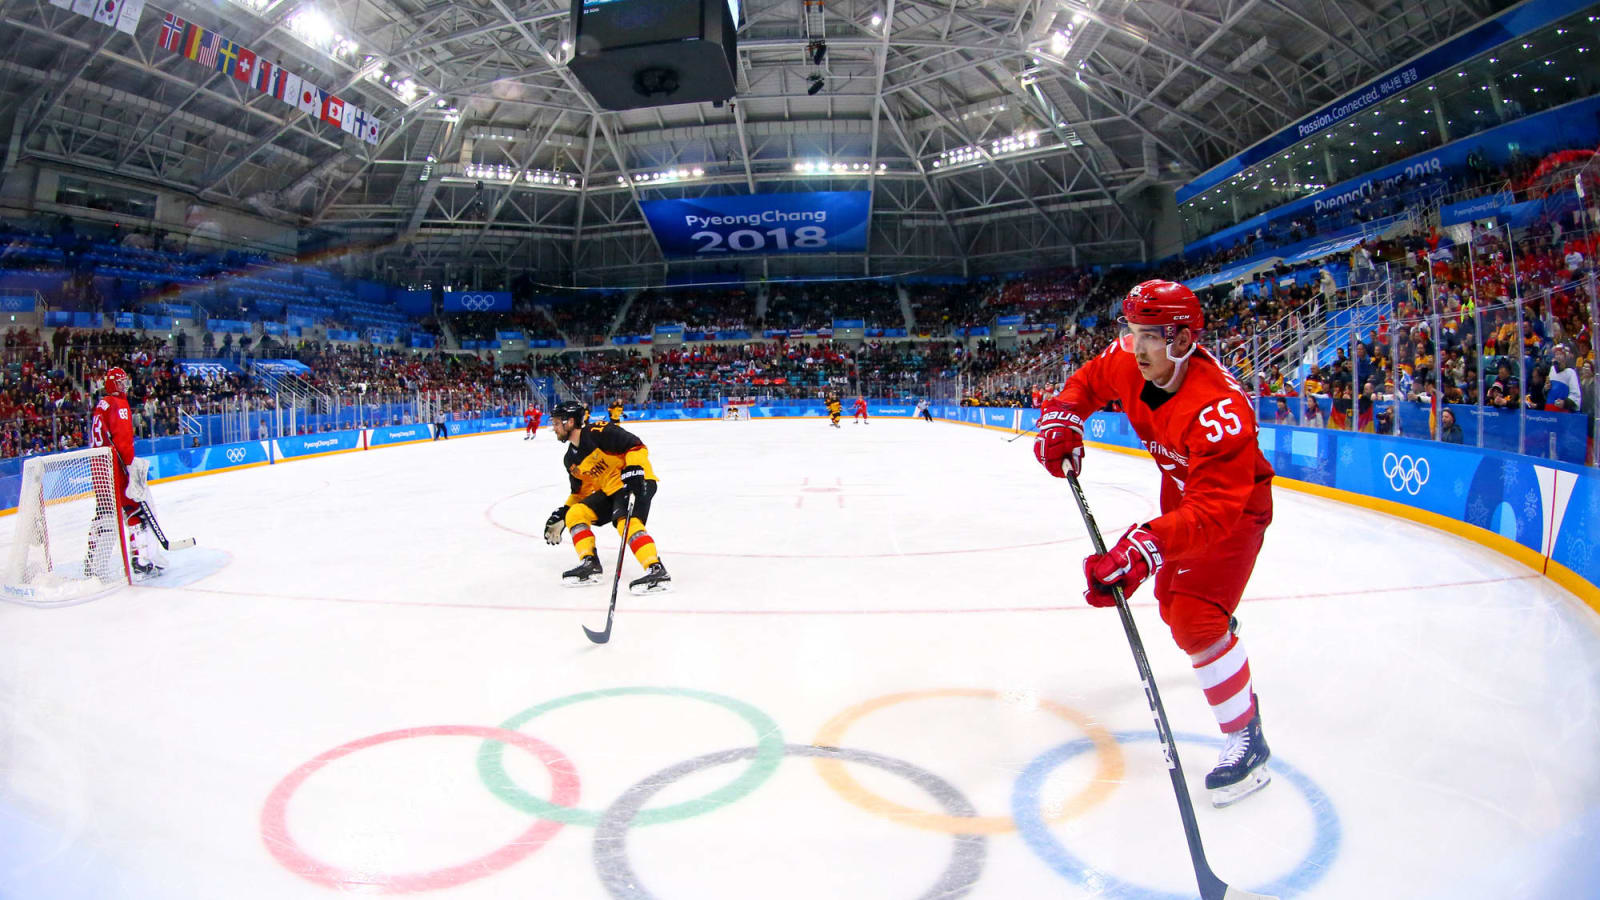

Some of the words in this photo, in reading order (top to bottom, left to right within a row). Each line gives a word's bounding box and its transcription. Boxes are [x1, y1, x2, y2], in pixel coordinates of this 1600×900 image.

[1332, 88, 1380, 119] Connected.
[685, 210, 827, 229] PyeongChang
[690, 225, 828, 252] 2018
[1199, 397, 1242, 443] 55
